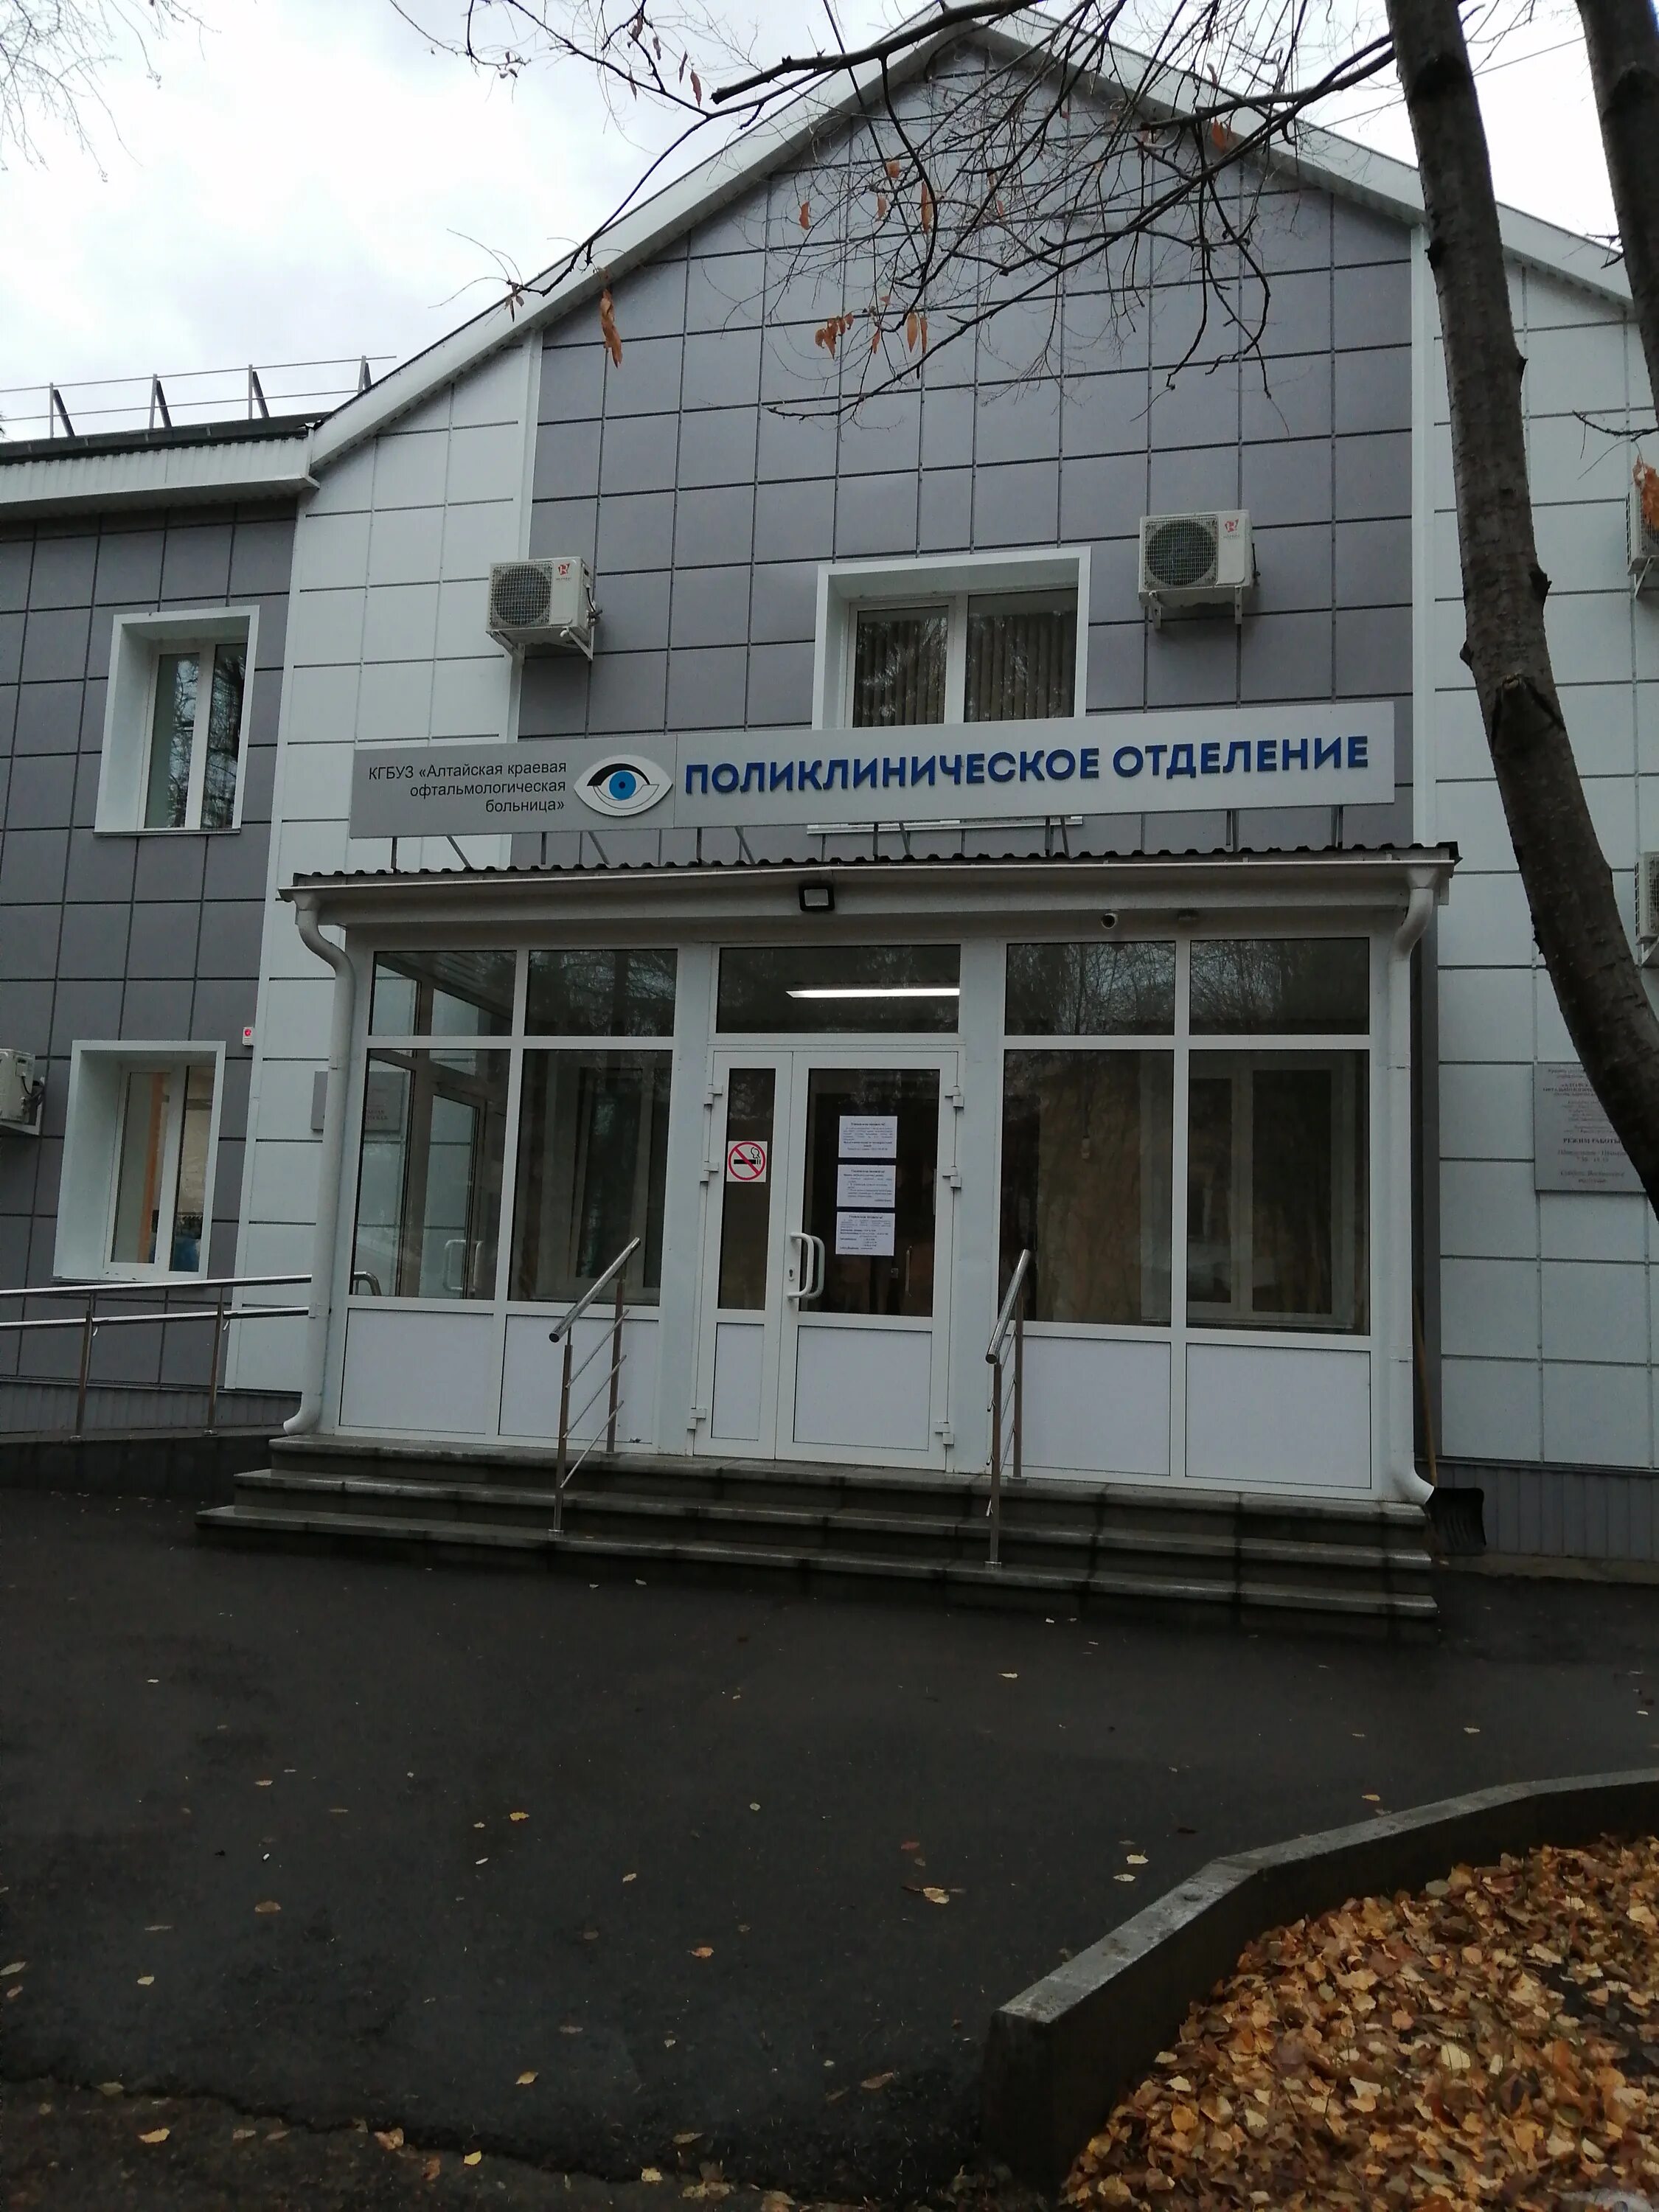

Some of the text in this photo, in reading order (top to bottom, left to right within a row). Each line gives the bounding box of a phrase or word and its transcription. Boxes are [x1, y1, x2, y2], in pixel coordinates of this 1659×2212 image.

[368, 762, 567, 780] КГБУЗ «Алтайская краевая
[684, 734, 1368, 795] ПОЛИКЛИНИЧЕСКОЕ ОТДЕЛЕНИЕ
[409, 781, 566, 799] офтальмологическая
[485, 799, 566, 813] больница»
